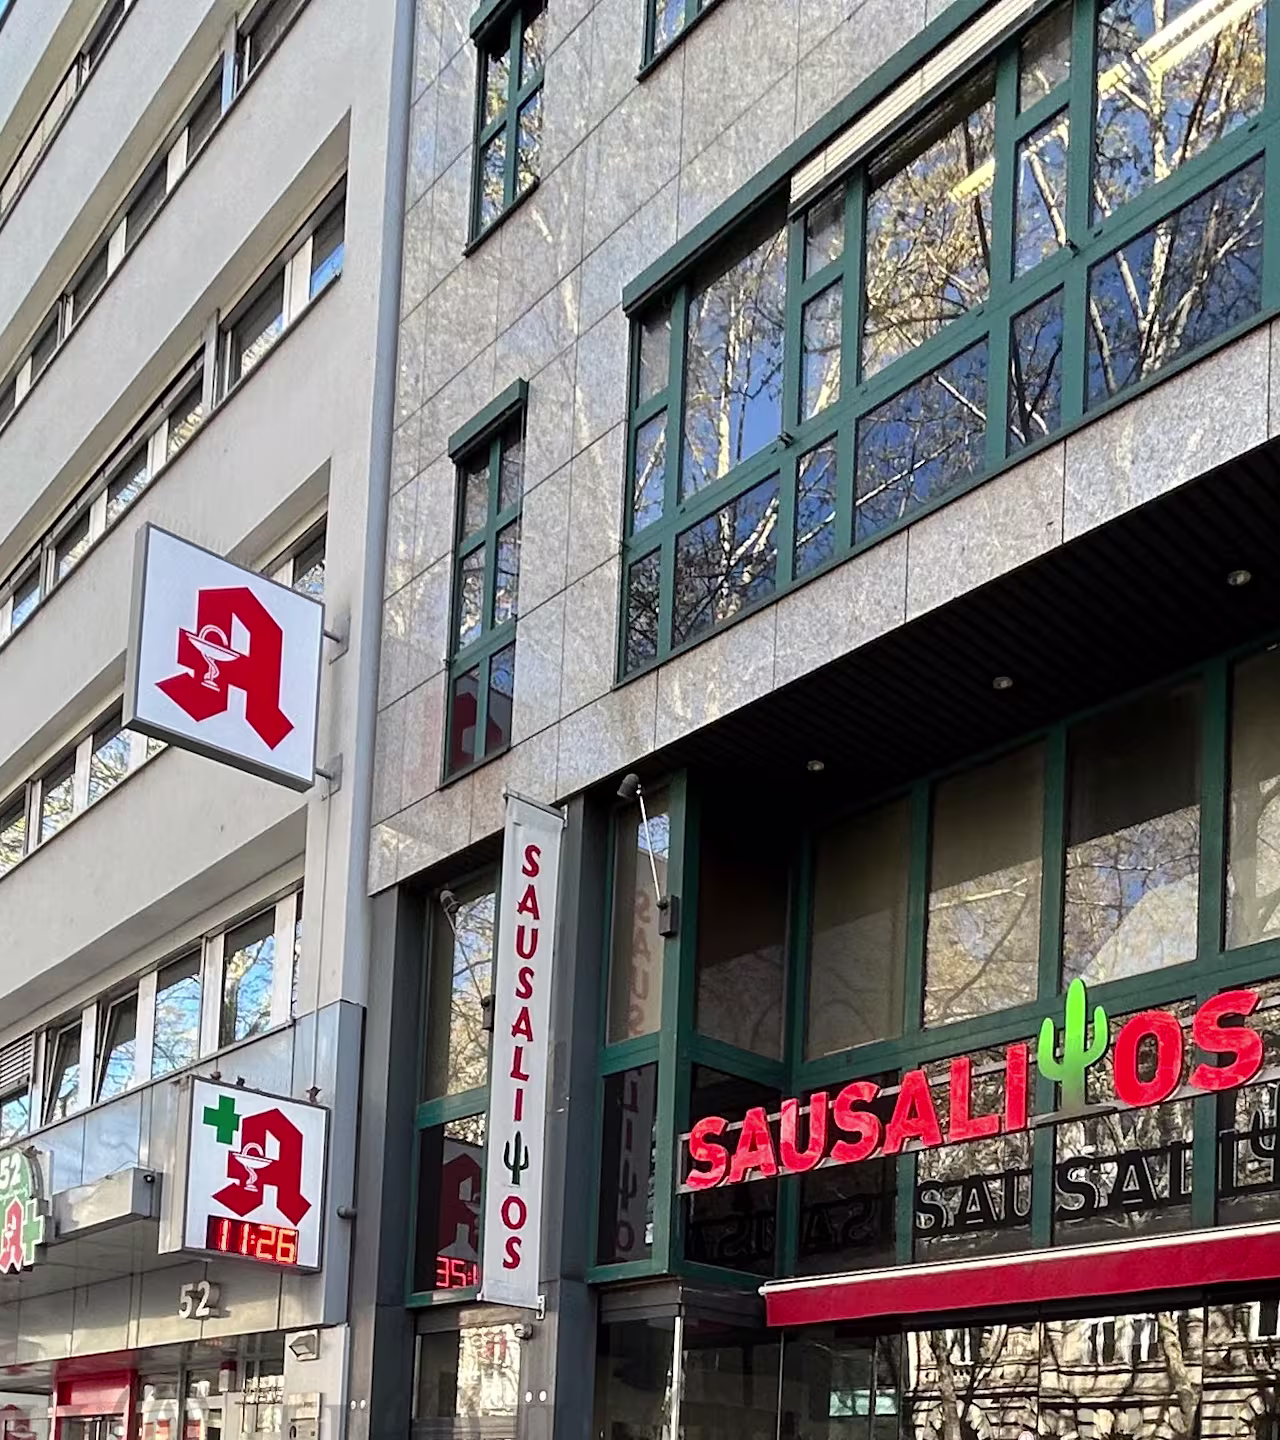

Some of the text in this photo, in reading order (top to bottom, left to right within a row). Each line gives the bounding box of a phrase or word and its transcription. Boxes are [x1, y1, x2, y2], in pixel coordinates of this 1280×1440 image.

[0, 1152, 21, 1190] 52
[219, 1219, 297, 1263] 11:26
[178, 1281, 210, 1319] 52
